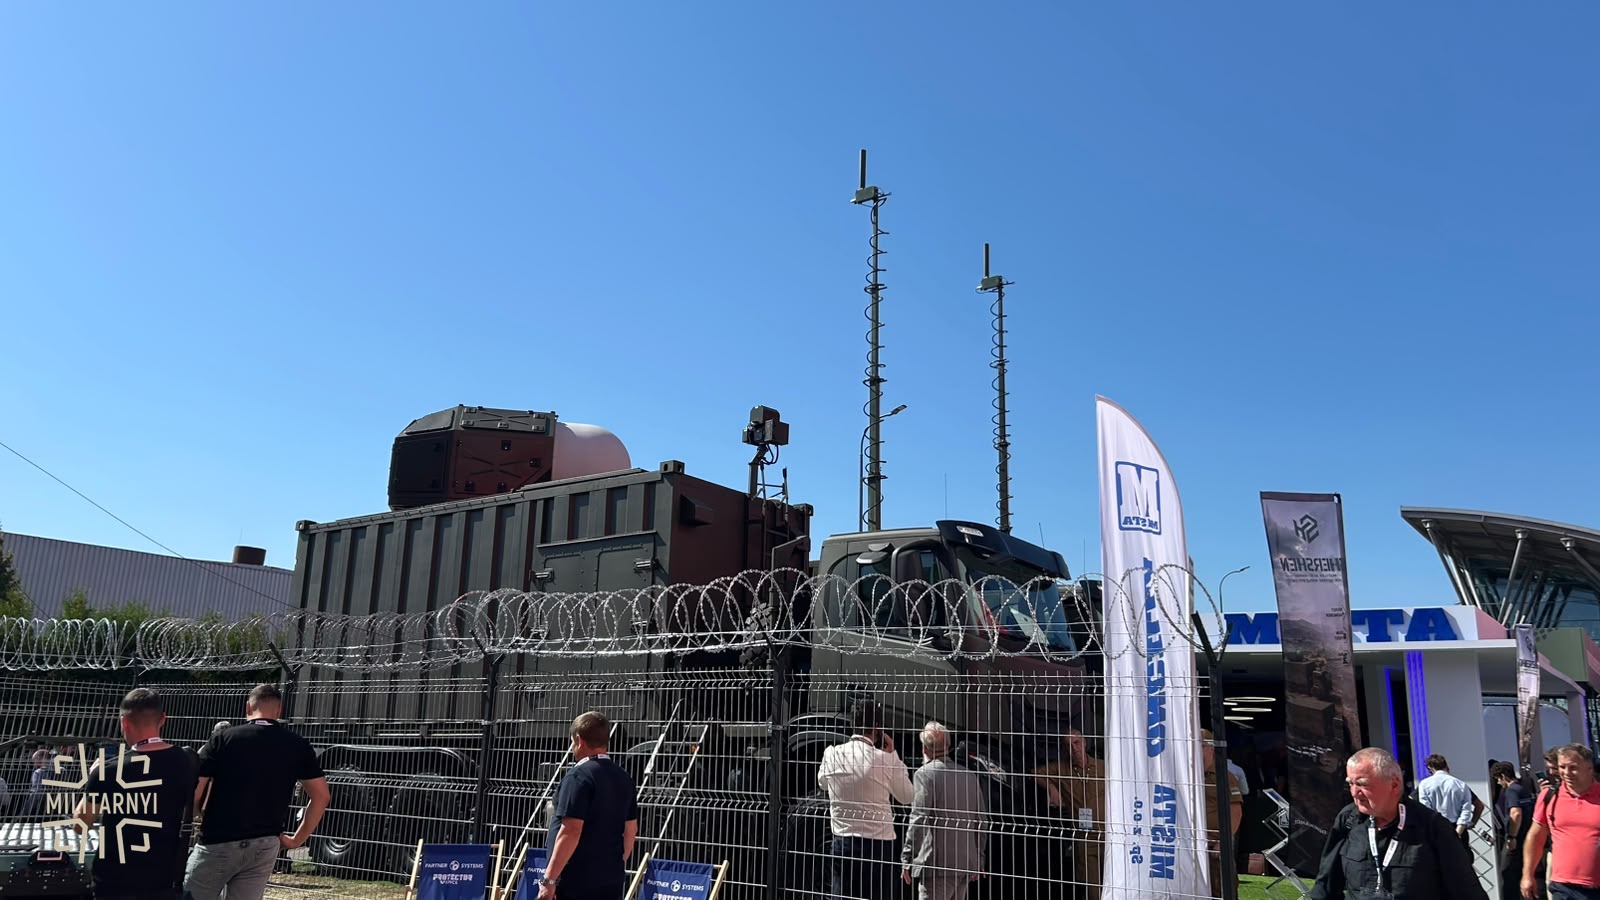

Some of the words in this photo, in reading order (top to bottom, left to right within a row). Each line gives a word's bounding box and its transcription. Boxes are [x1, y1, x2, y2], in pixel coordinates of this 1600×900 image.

[1224, 607, 1457, 644] MTA
[432, 873, 473, 881] PROTECTOR
[646, 878, 670, 888] PARTNER
[681, 883, 705, 892] SYSTEMS
